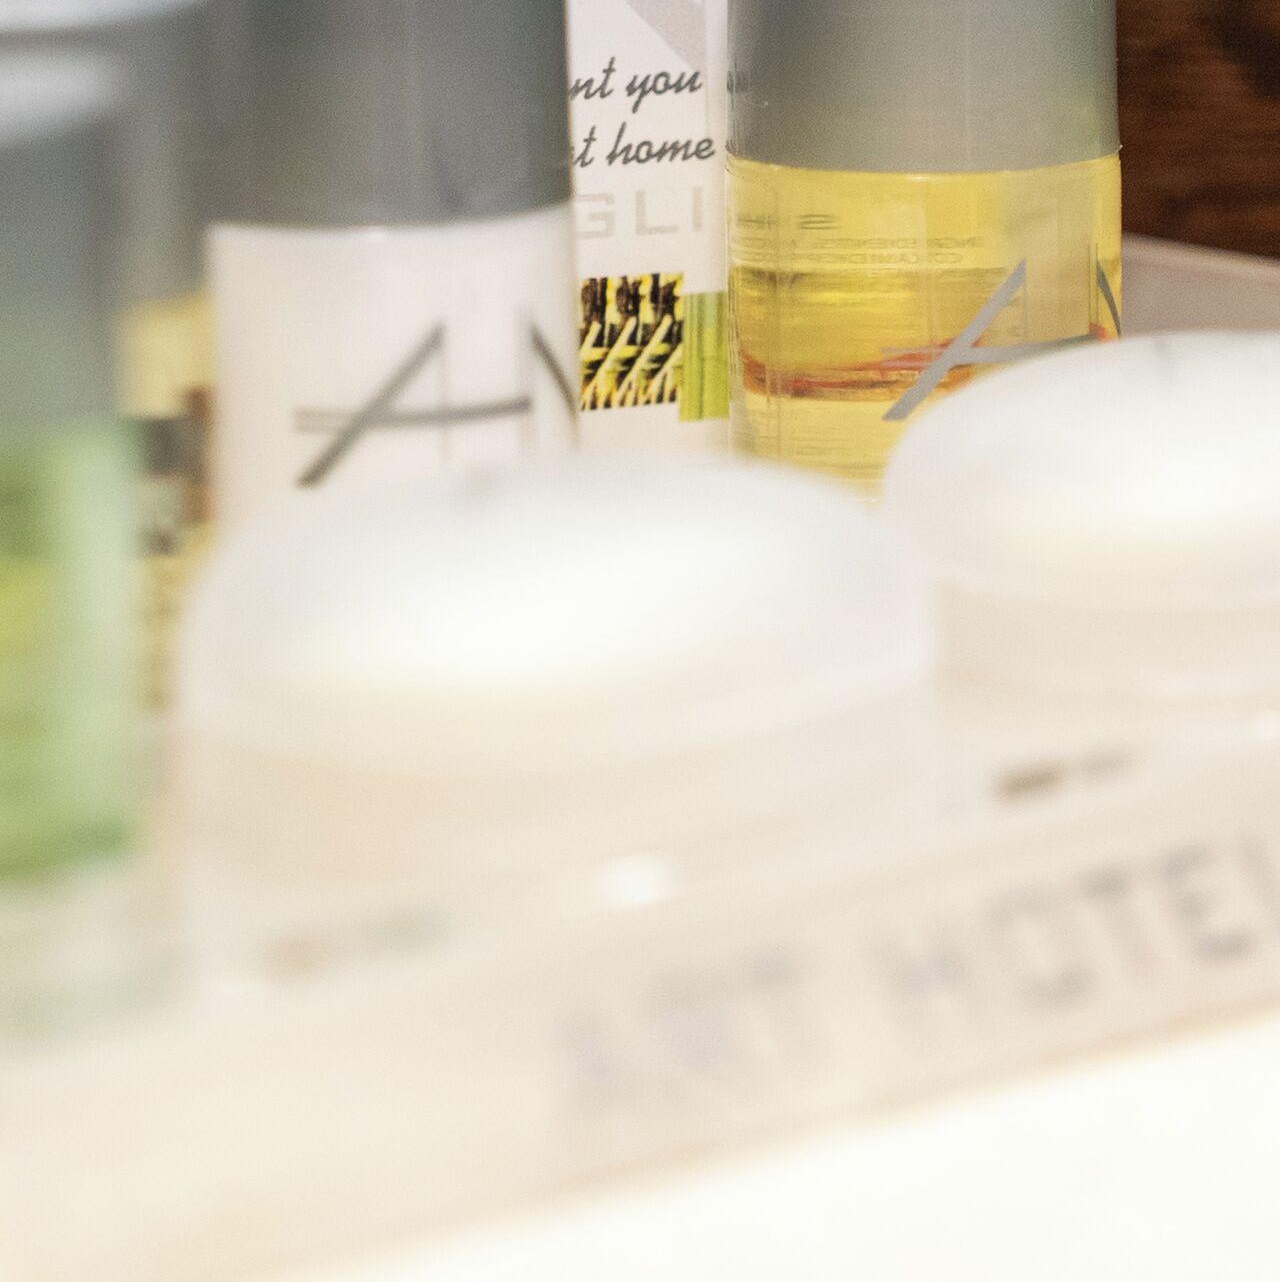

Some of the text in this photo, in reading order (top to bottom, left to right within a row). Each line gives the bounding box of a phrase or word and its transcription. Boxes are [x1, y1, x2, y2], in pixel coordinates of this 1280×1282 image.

[569, 56, 616, 101] nt
[626, 71, 702, 114] you
[572, 121, 716, 168] t home
[575, 187, 704, 238] GLI
